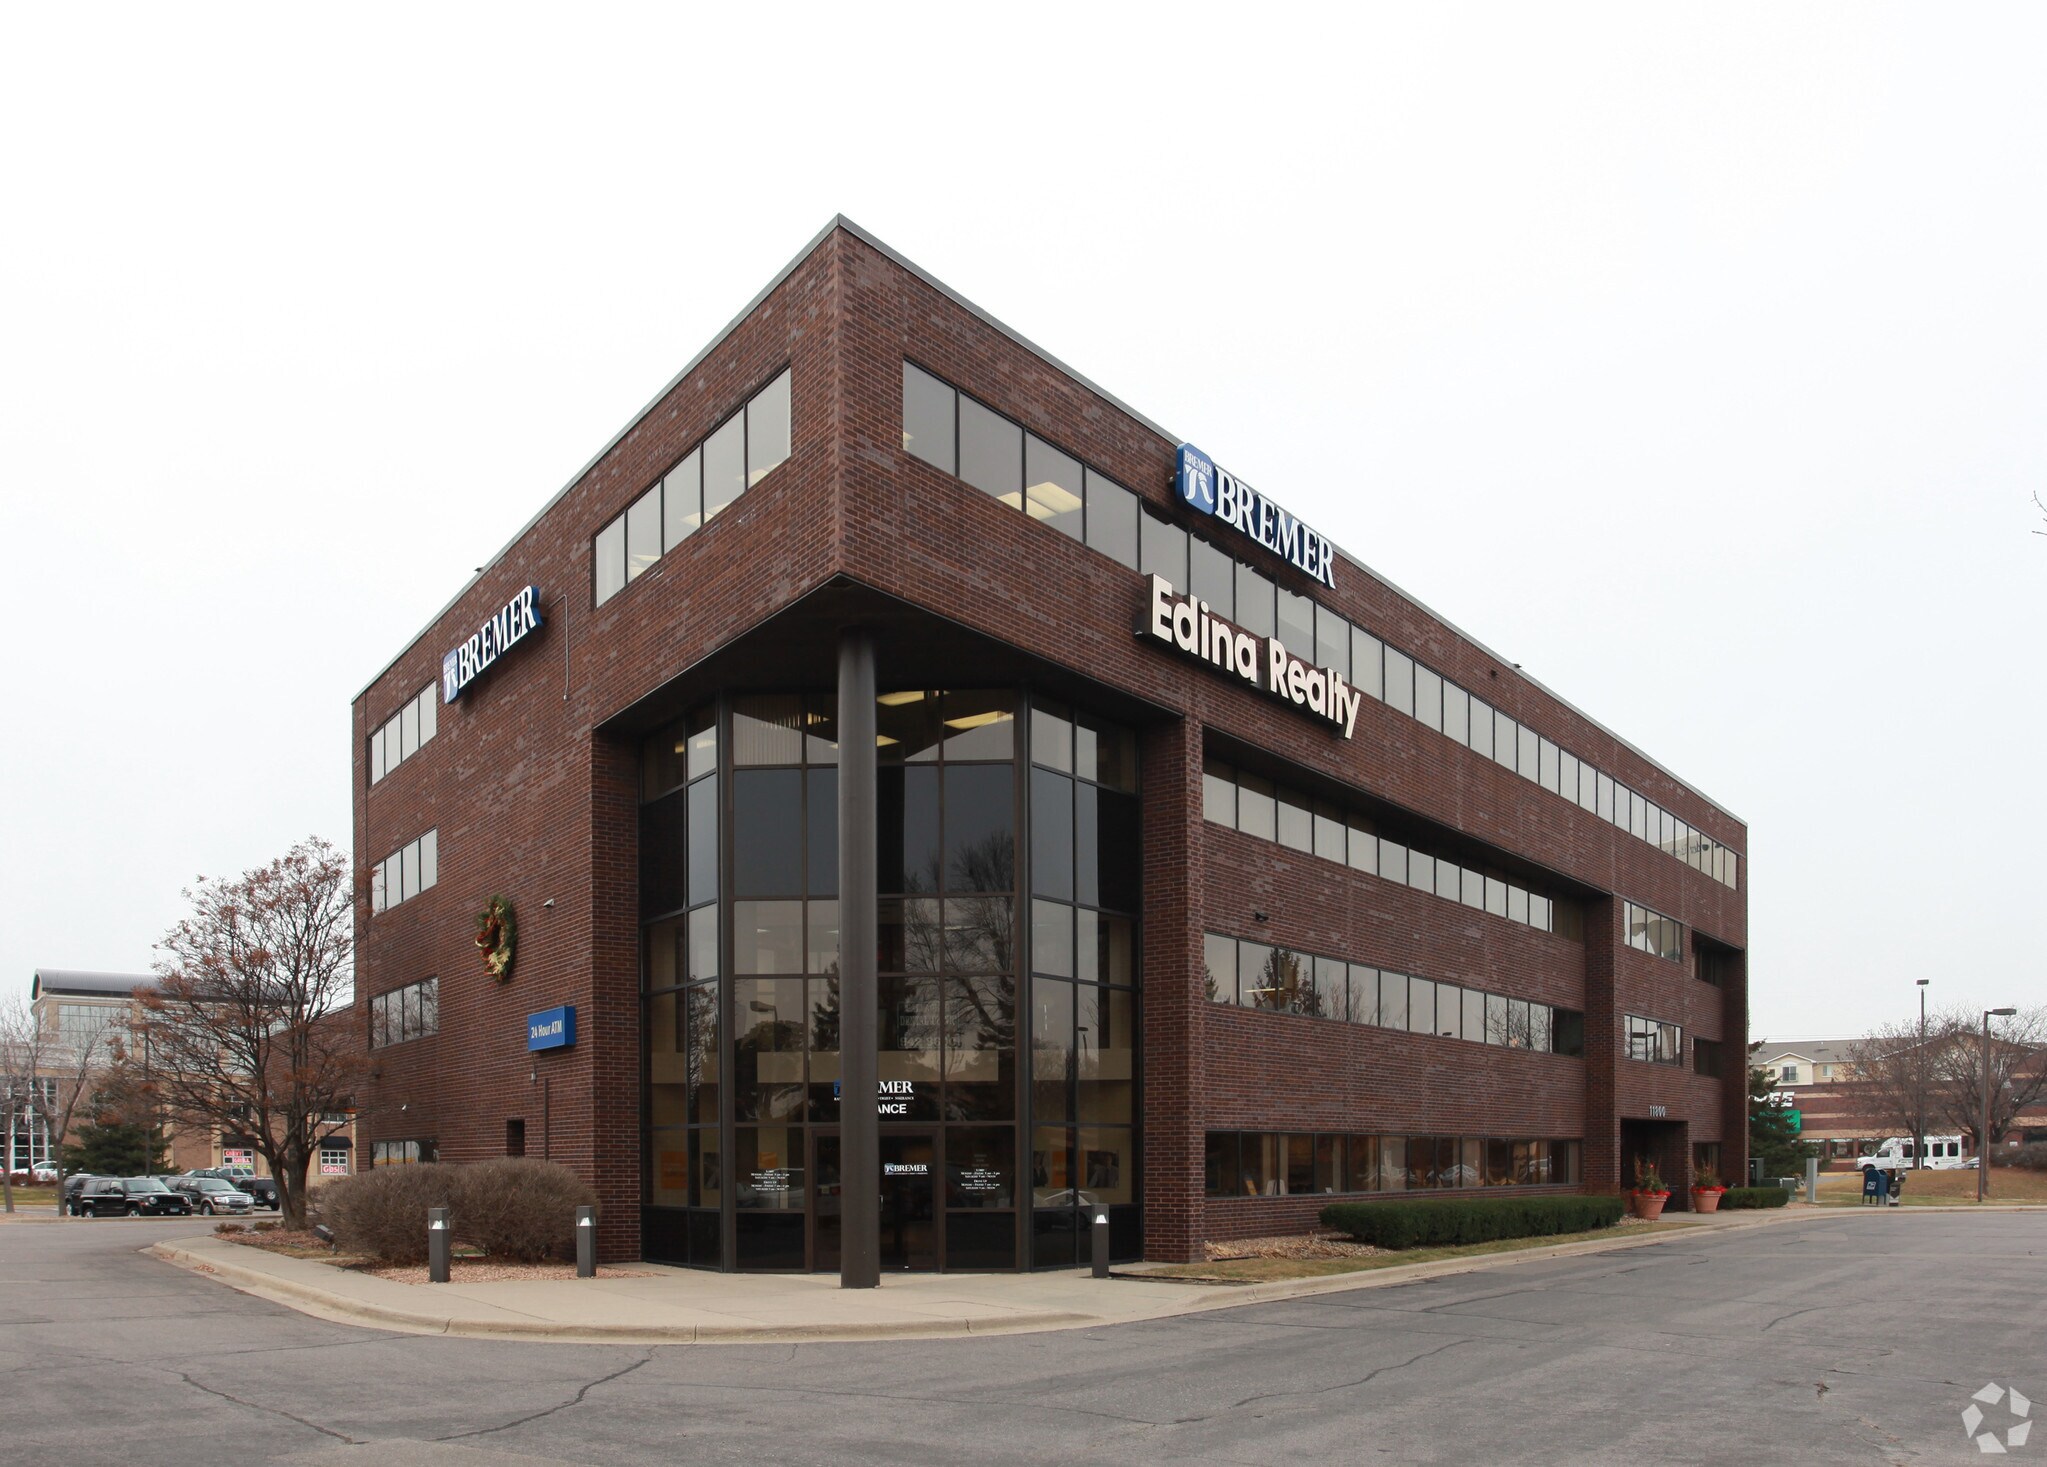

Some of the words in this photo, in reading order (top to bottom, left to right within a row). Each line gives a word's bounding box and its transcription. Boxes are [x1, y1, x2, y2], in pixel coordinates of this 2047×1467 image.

[1184, 450, 1213, 477] BREMER
[1215, 466, 1336, 589] BREMER
[458, 585, 537, 689] BREMER
[1152, 573, 1258, 683] Edina
[1269, 637, 1361, 740] Realty
[531, 1026, 538, 1038] 24
[538, 1024, 551, 1037] Hour
[551, 1020, 563, 1035] ATM
[878, 1081, 914, 1094] MER
[894, 1164, 928, 1172] BREMER
